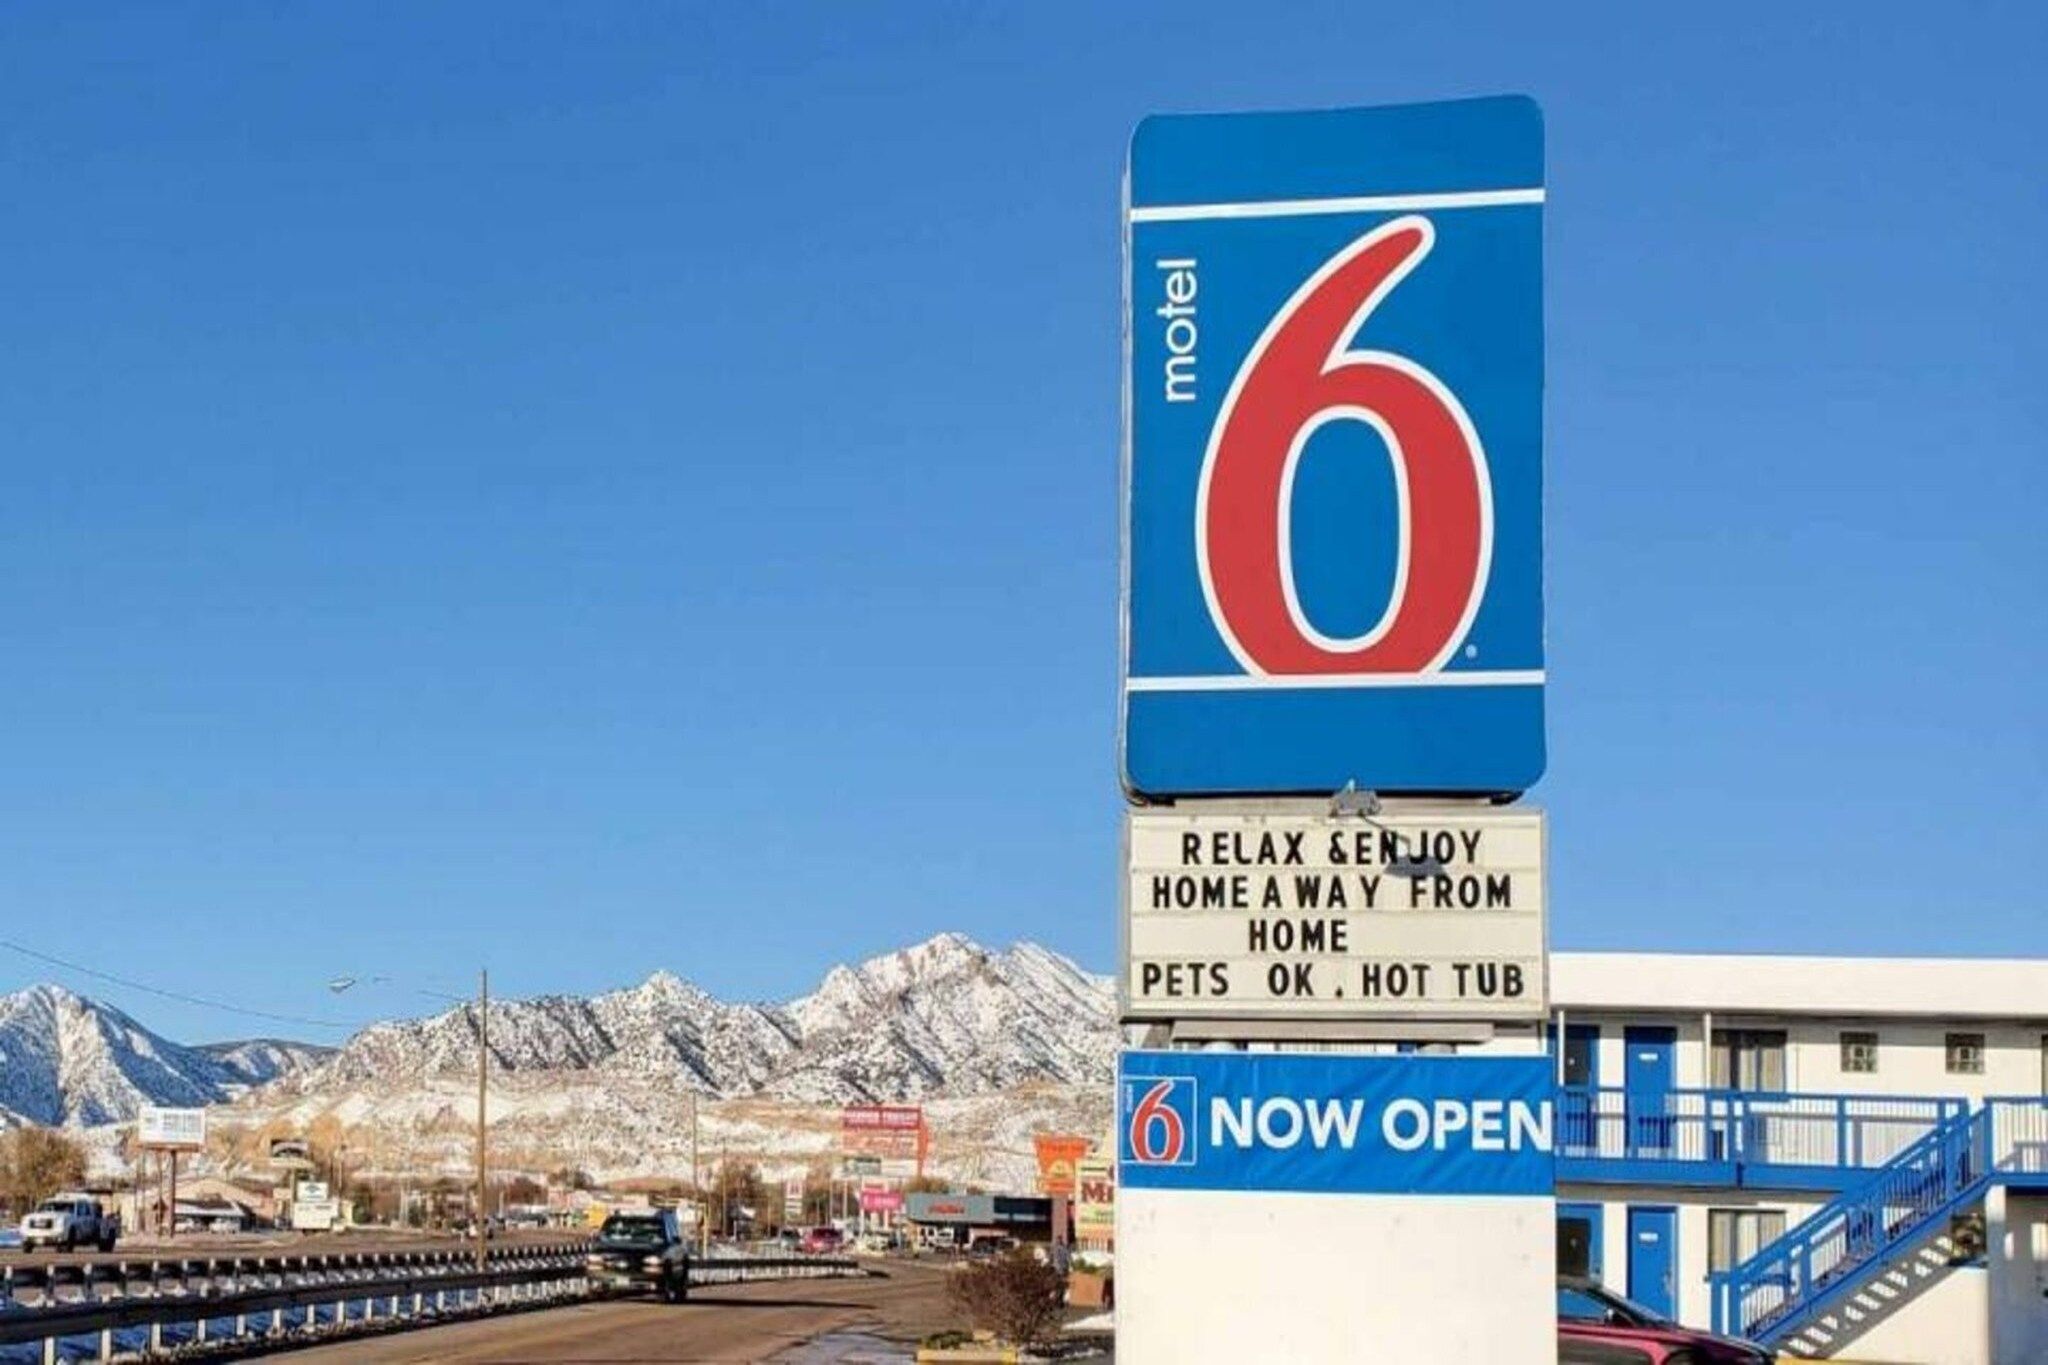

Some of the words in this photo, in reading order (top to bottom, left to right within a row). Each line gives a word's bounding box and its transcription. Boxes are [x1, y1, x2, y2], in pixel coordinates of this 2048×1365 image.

[1157, 258, 1197, 402] motel
[1195, 214, 1494, 676] 6
[1181, 831, 1304, 865] RELAX
[1410, 874, 1511, 909] FROM
[1248, 919, 1348, 952] HOME
[1142, 962, 1229, 996] PETS
[1362, 963, 1431, 997] HOT
[1452, 962, 1524, 998] TUB
[1129, 1079, 1184, 1164] 6
[1210, 1097, 1364, 1148] NOW
[1382, 1099, 1552, 1151] OPEN
